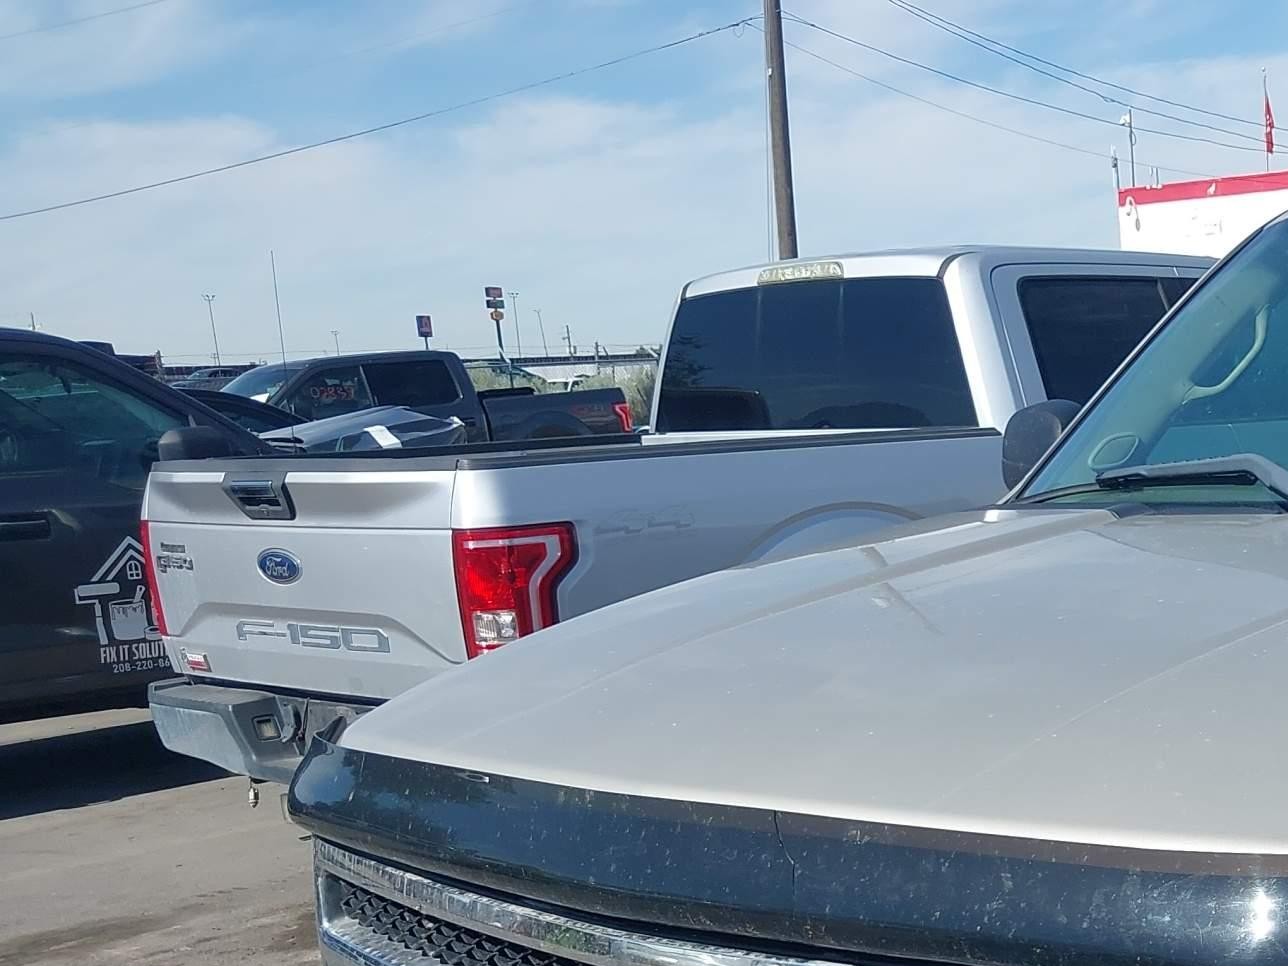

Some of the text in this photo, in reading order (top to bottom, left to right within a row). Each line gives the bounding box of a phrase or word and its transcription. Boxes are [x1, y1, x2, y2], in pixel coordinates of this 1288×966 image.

[264, 555, 291, 579] Ford
[236, 619, 391, 653] F-150
[100, 646, 118, 664] FIX
[118, 644, 131, 662] IT
